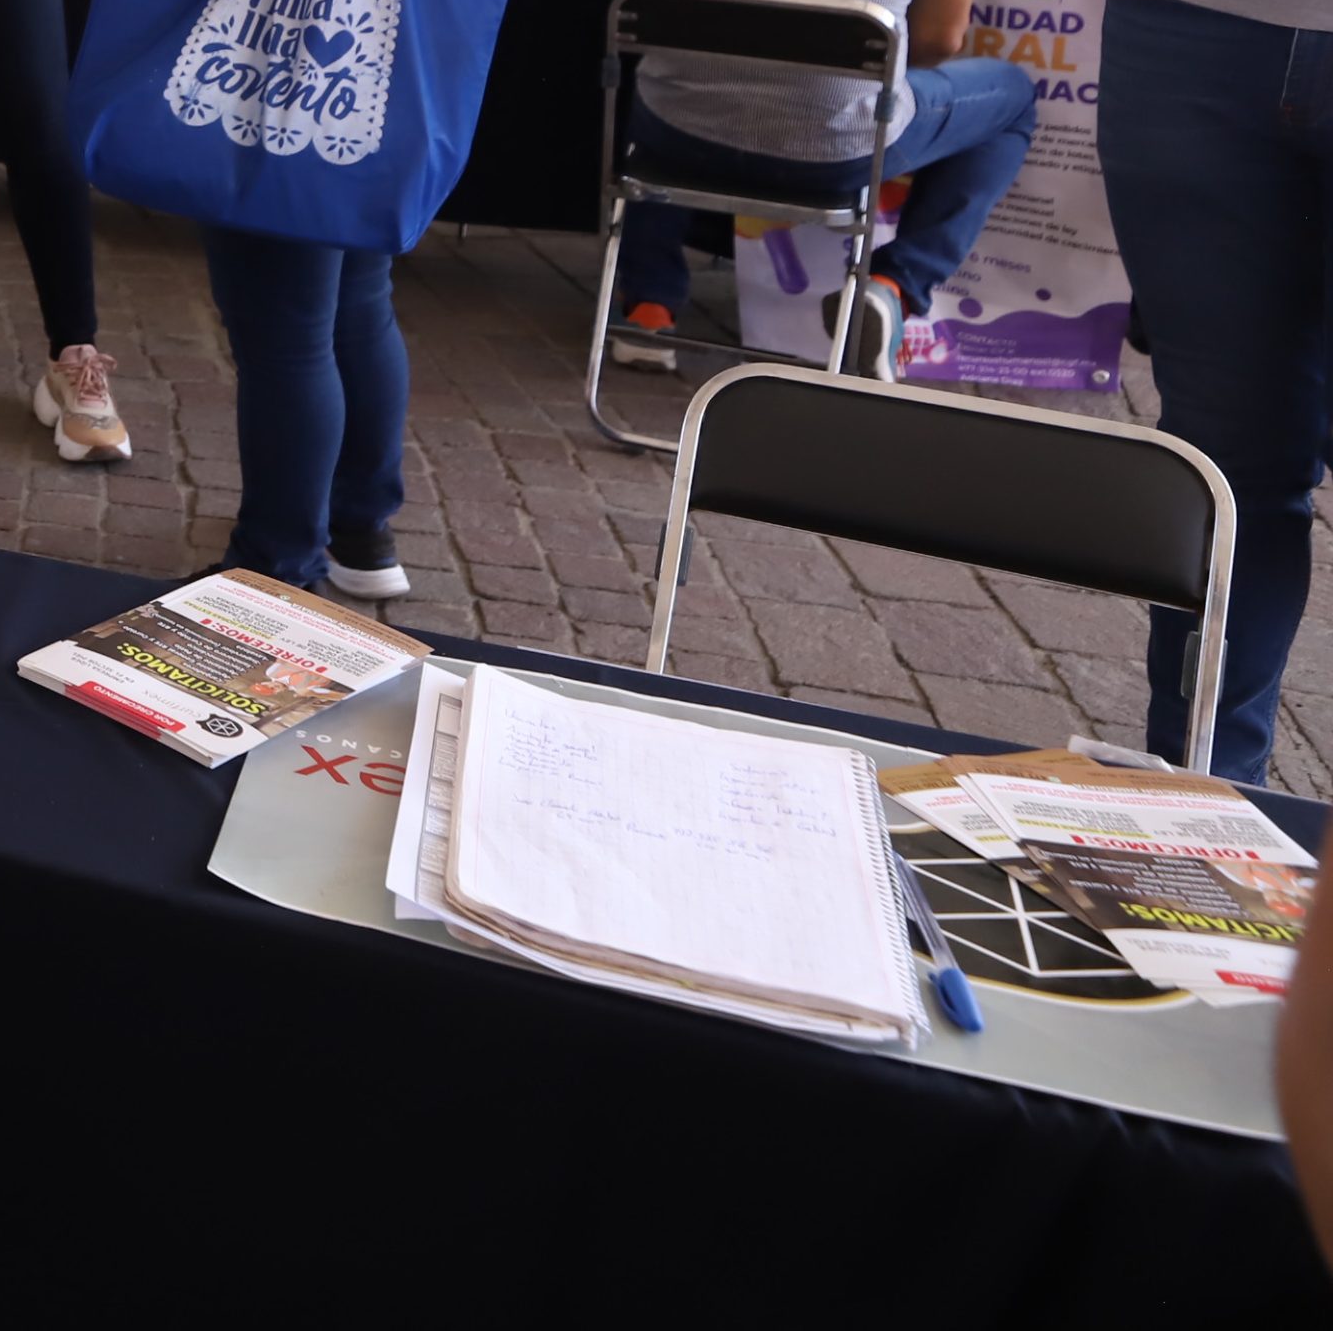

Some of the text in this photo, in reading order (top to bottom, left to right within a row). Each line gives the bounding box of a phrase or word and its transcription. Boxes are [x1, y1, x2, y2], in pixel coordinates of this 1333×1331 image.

[962, 27, 1078, 72] RAL
[984, 256, 1032, 273] meses
[207, 622, 318, 668] OFRECEMOS:
[90, 685, 155, 716] CRECIMIENTO
[111, 641, 267, 715] SOLICITAMOS:
